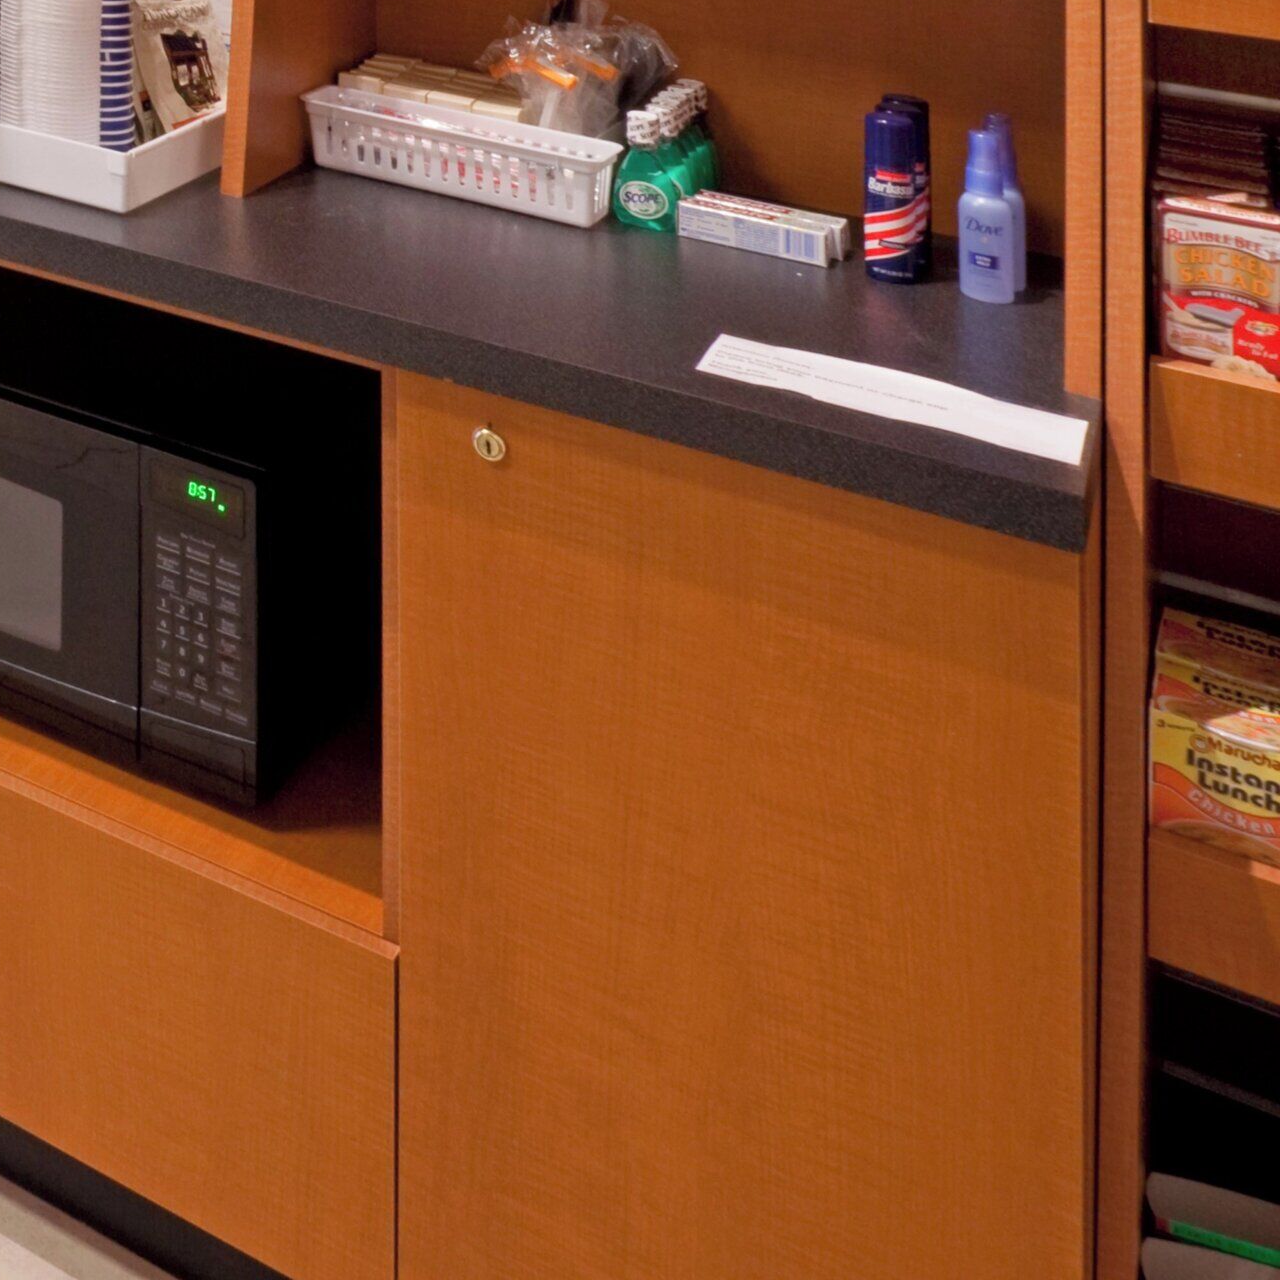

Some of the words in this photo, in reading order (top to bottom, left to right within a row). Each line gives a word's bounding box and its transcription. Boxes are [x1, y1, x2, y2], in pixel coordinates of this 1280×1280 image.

[867, 176, 914, 196] Barbasol
[965, 217, 1003, 237] Dove
[1166, 227, 1231, 248] BUMBLE
[1234, 236, 1264, 253] BEE
[1174, 246, 1276, 283] CHICKEN
[1179, 267, 1271, 299] SALAD
[187, 480, 217, 503] 8:57
[1205, 733, 1280, 772] Marucha
[1186, 747, 1280, 795] Instan
[1197, 769, 1280, 815] Lunch
[1188, 786, 1277, 836] Chicken
